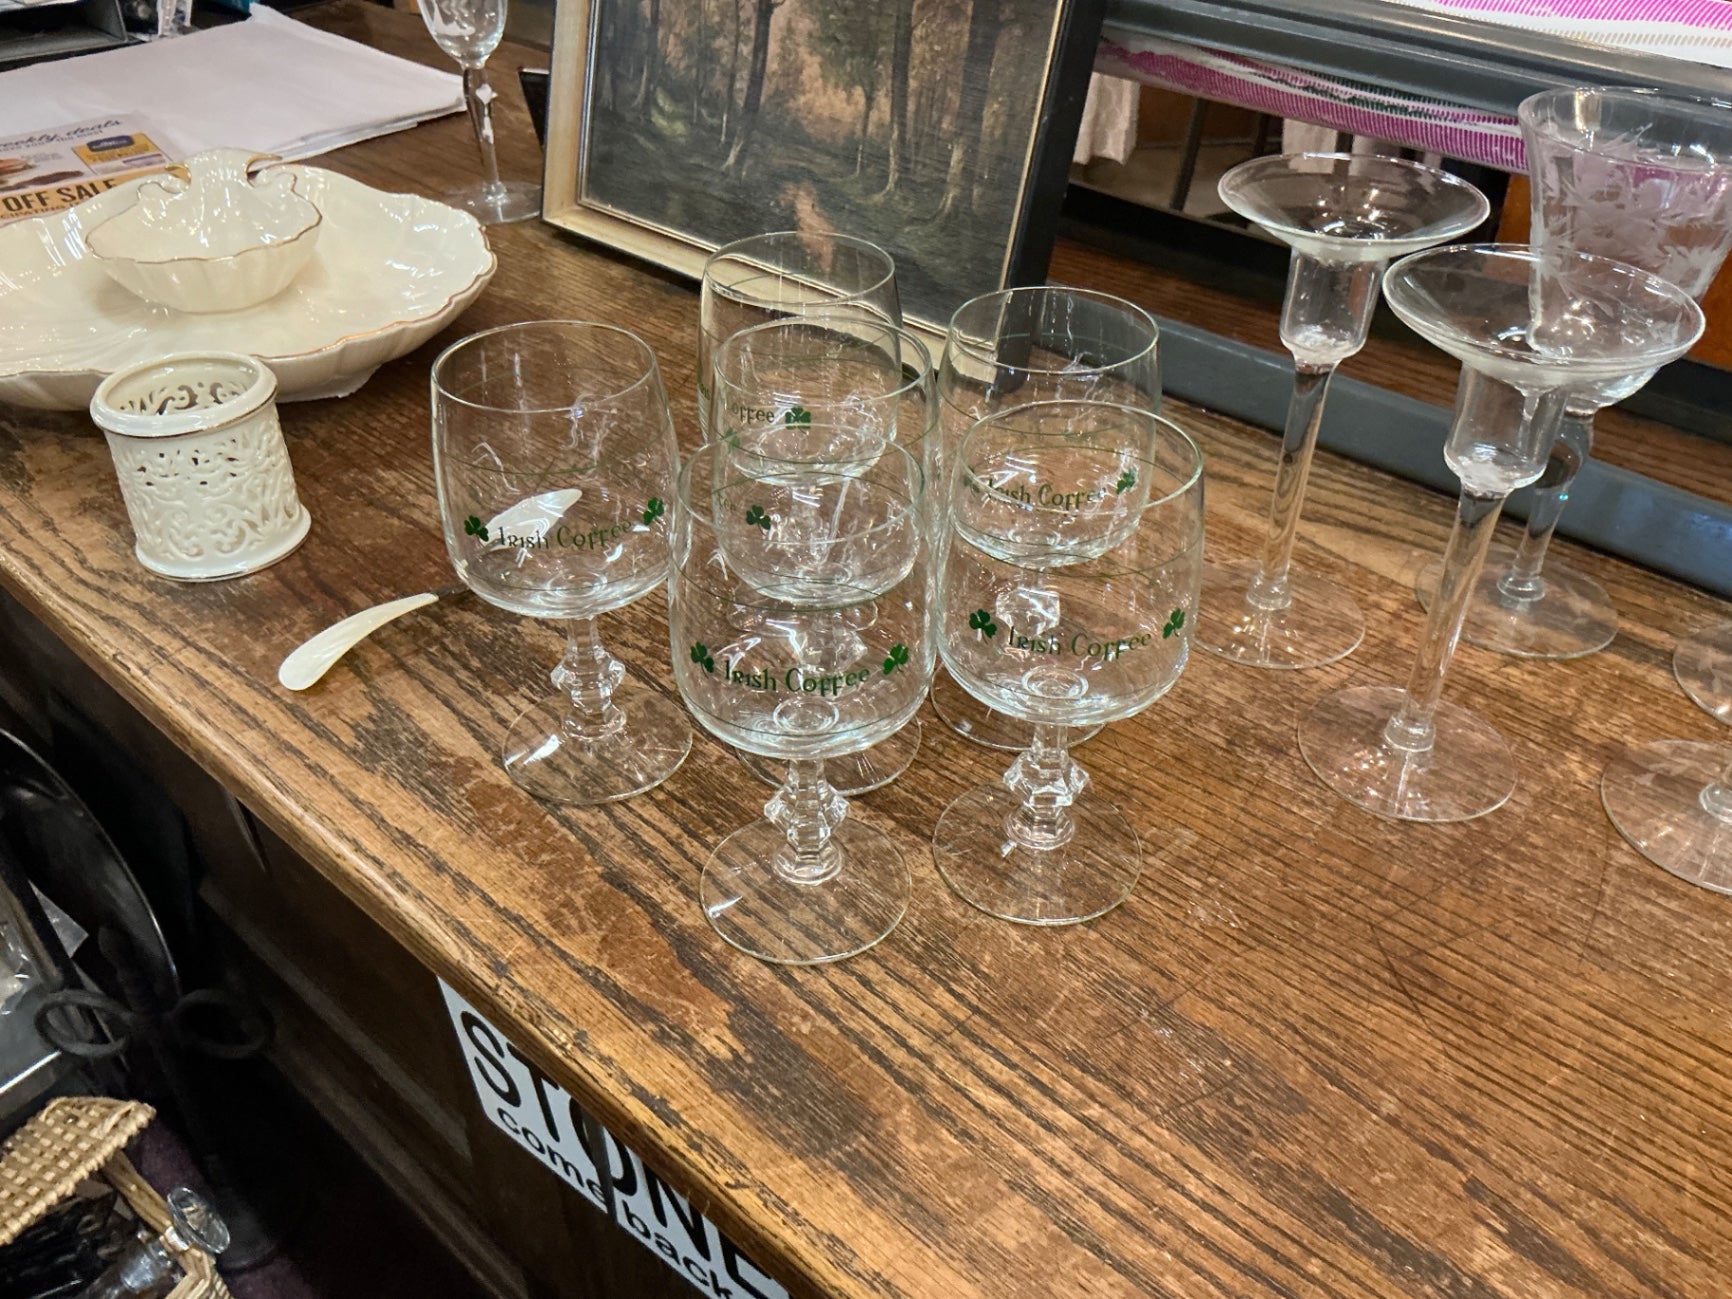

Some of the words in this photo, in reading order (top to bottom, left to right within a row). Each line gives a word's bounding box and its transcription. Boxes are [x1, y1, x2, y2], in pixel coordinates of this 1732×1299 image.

[0, 133, 59, 148] eekly
[66, 119, 123, 137] deals
[2, 190, 50, 212] OFF
[731, 403, 776, 425] offee
[1038, 483, 1108, 512] Coffee
[498, 526, 550, 550] Irish
[557, 520, 632, 550] Coffee
[1008, 625, 1062, 656] Irish
[1071, 631, 1152, 661] Coffee
[724, 659, 777, 691] Irish
[785, 667, 871, 697] Coffee
[497, 1107, 608, 1205] come
[621, 1200, 734, 1299] back
